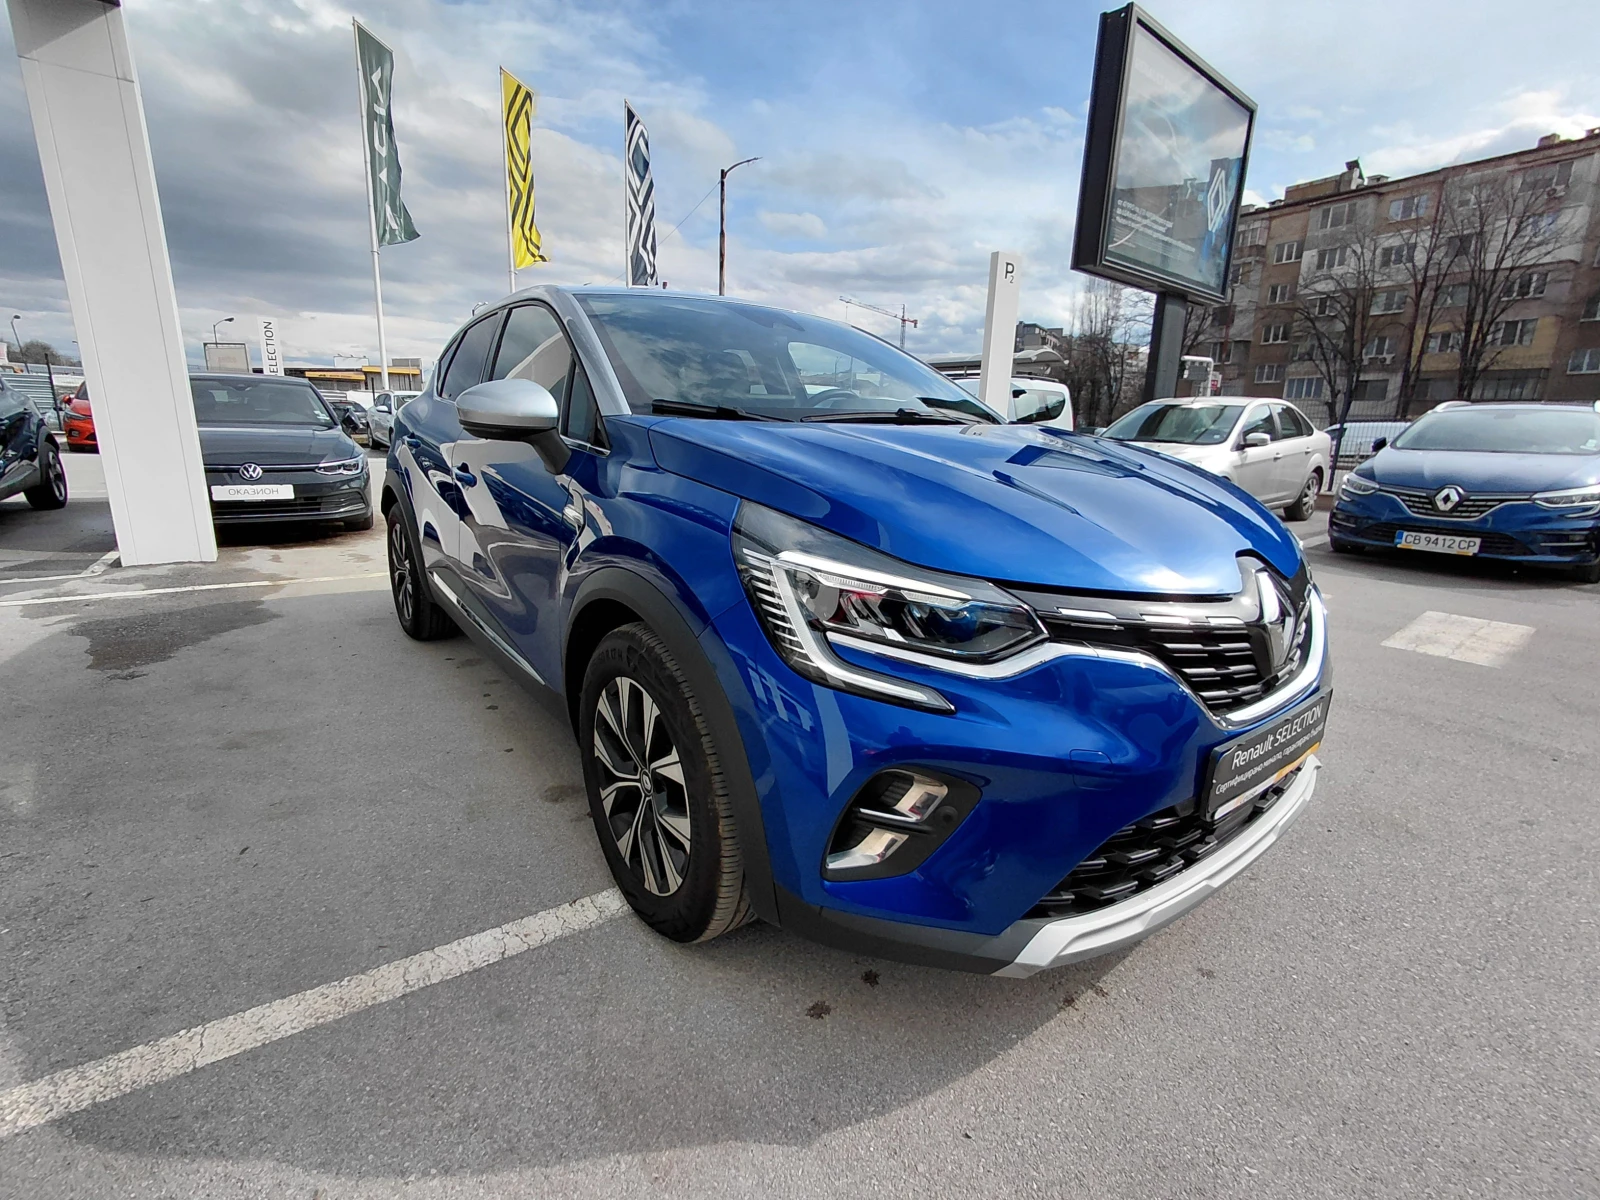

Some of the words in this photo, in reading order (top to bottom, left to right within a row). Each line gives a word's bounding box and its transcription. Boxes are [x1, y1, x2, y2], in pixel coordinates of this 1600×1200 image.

[263, 321, 279, 376] ELECTION
[228, 487, 279, 496] ОКАЗИОН
[1404, 533, 1421, 545] CB
[1424, 536, 1456, 549] 9412
[1457, 539, 1477, 550] CP
[1232, 734, 1274, 770] Renault
[1274, 702, 1323, 747] SELECTION
